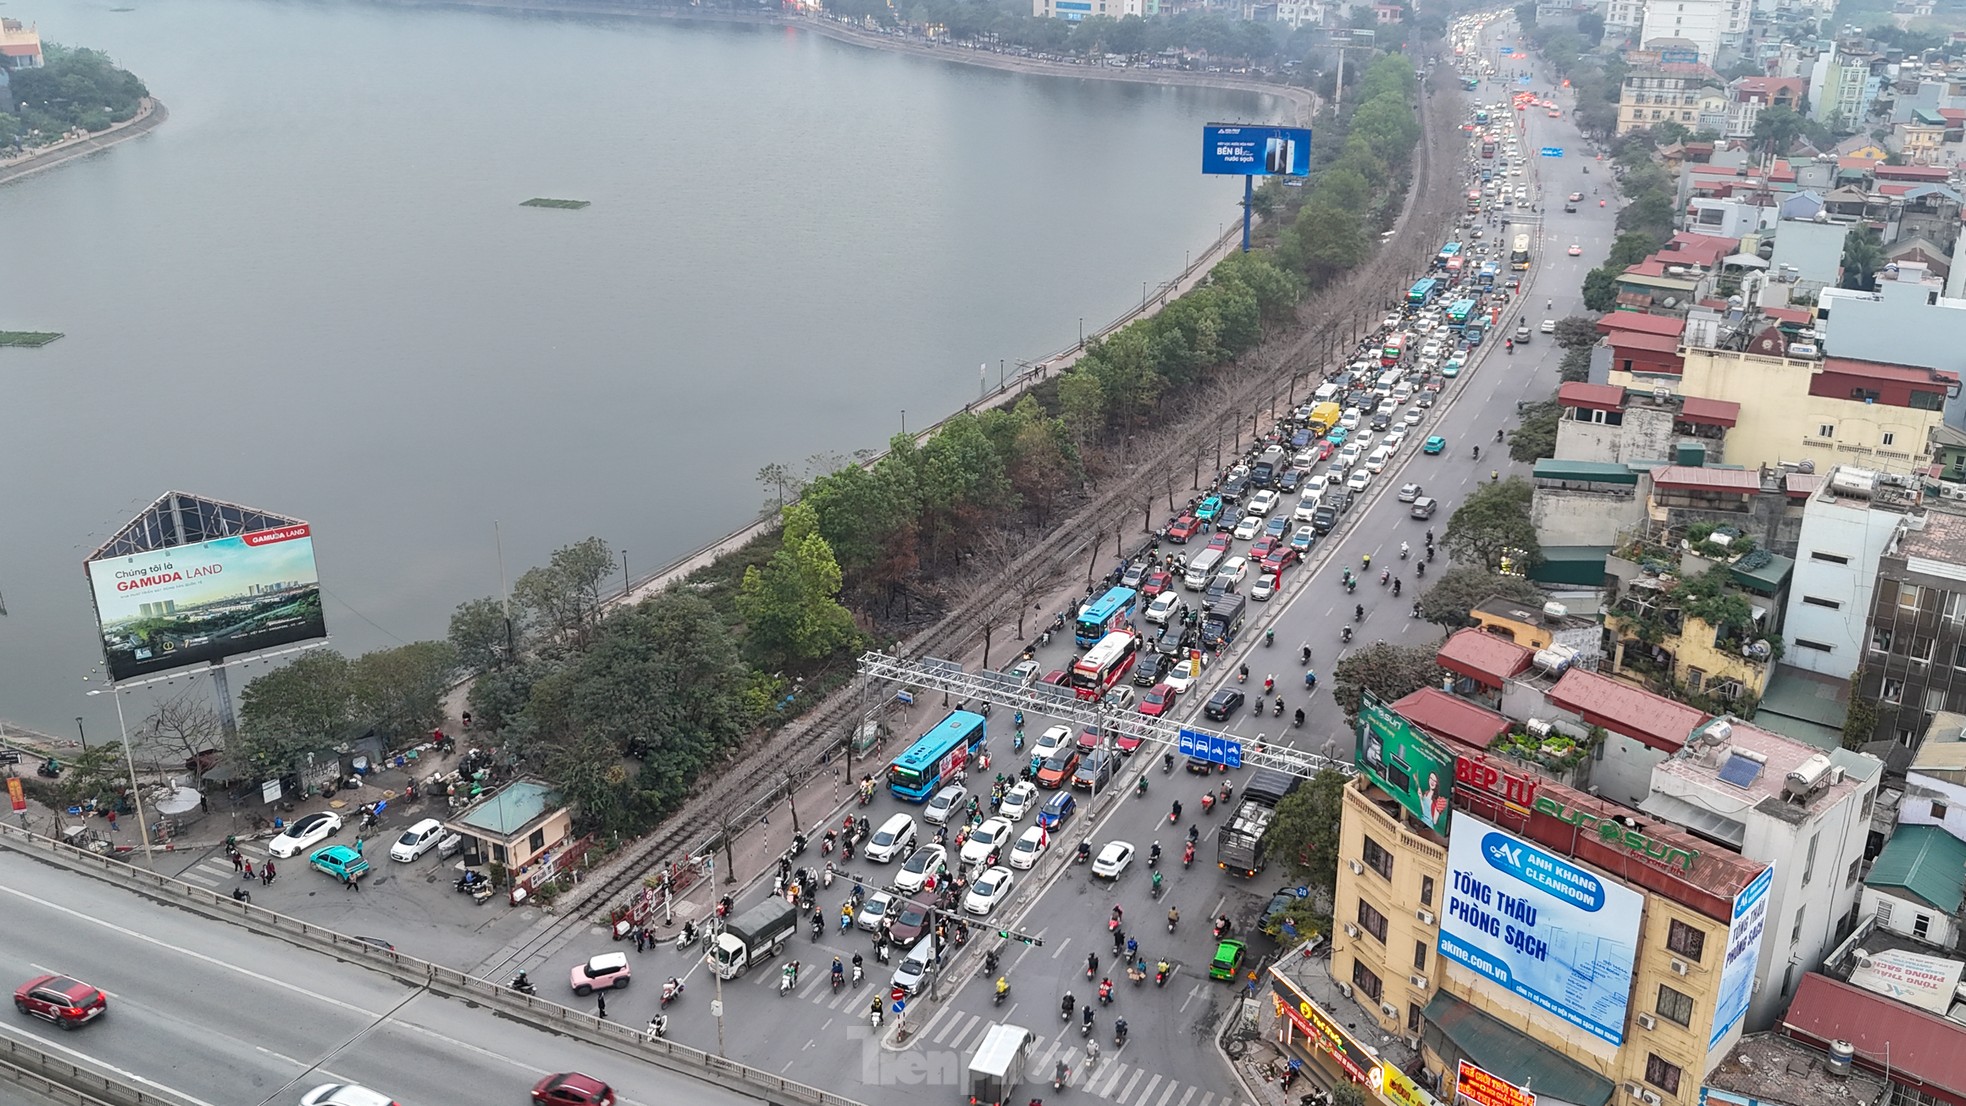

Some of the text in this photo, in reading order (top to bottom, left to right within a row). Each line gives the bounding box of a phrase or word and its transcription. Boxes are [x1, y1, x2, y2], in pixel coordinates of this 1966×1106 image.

[286, 528, 305, 538] LAND
[115, 568, 147, 579] Chúng
[149, 563, 162, 573] tôi
[117, 563, 223, 592] GAMUDA LAND
[1456, 755, 1498, 791] BẾP
[1503, 772, 1537, 807] TỪ
[1298, 888, 1307, 897] 20
[1525, 867, 1595, 906] CLEANROOM
[1527, 853, 1552, 873] ANH
[1555, 867, 1597, 893] KHANG
[1453, 869, 1537, 928] TỔNG THẦU
[1449, 896, 1547, 962] PHÒNG SẠCH
[1441, 939, 1508, 981] akme.com.vn
